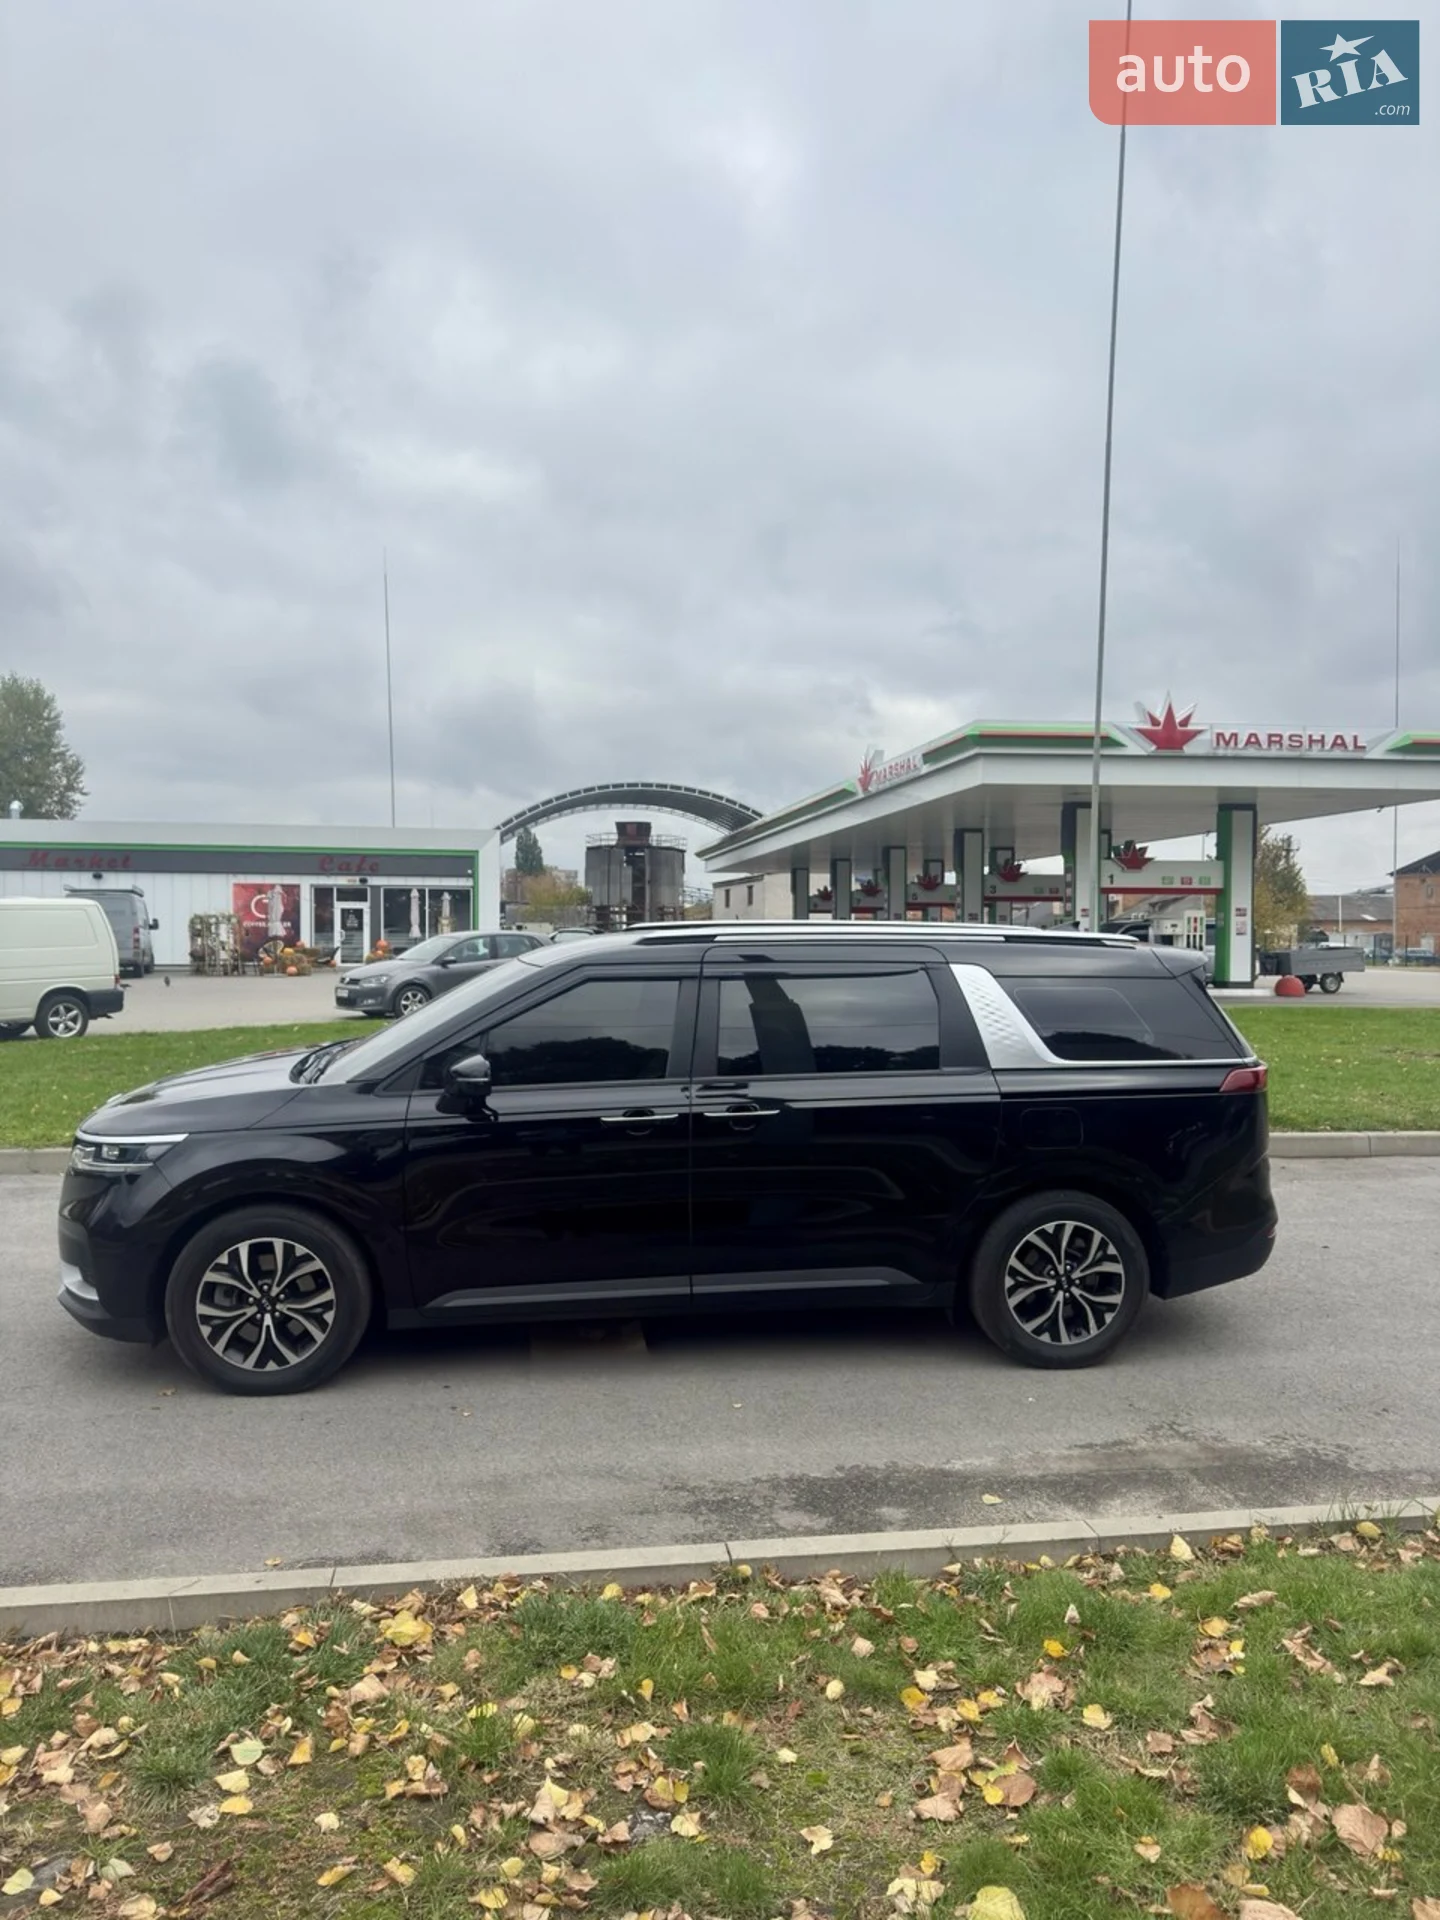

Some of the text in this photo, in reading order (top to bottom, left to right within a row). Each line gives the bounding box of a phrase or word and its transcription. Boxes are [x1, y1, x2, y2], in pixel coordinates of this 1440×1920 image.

[1215, 731, 1367, 750] MARSHAL
[871, 755, 918, 785] MARSHAL
[22, 851, 133, 870] Market
[319, 854, 379, 873] Cafe
